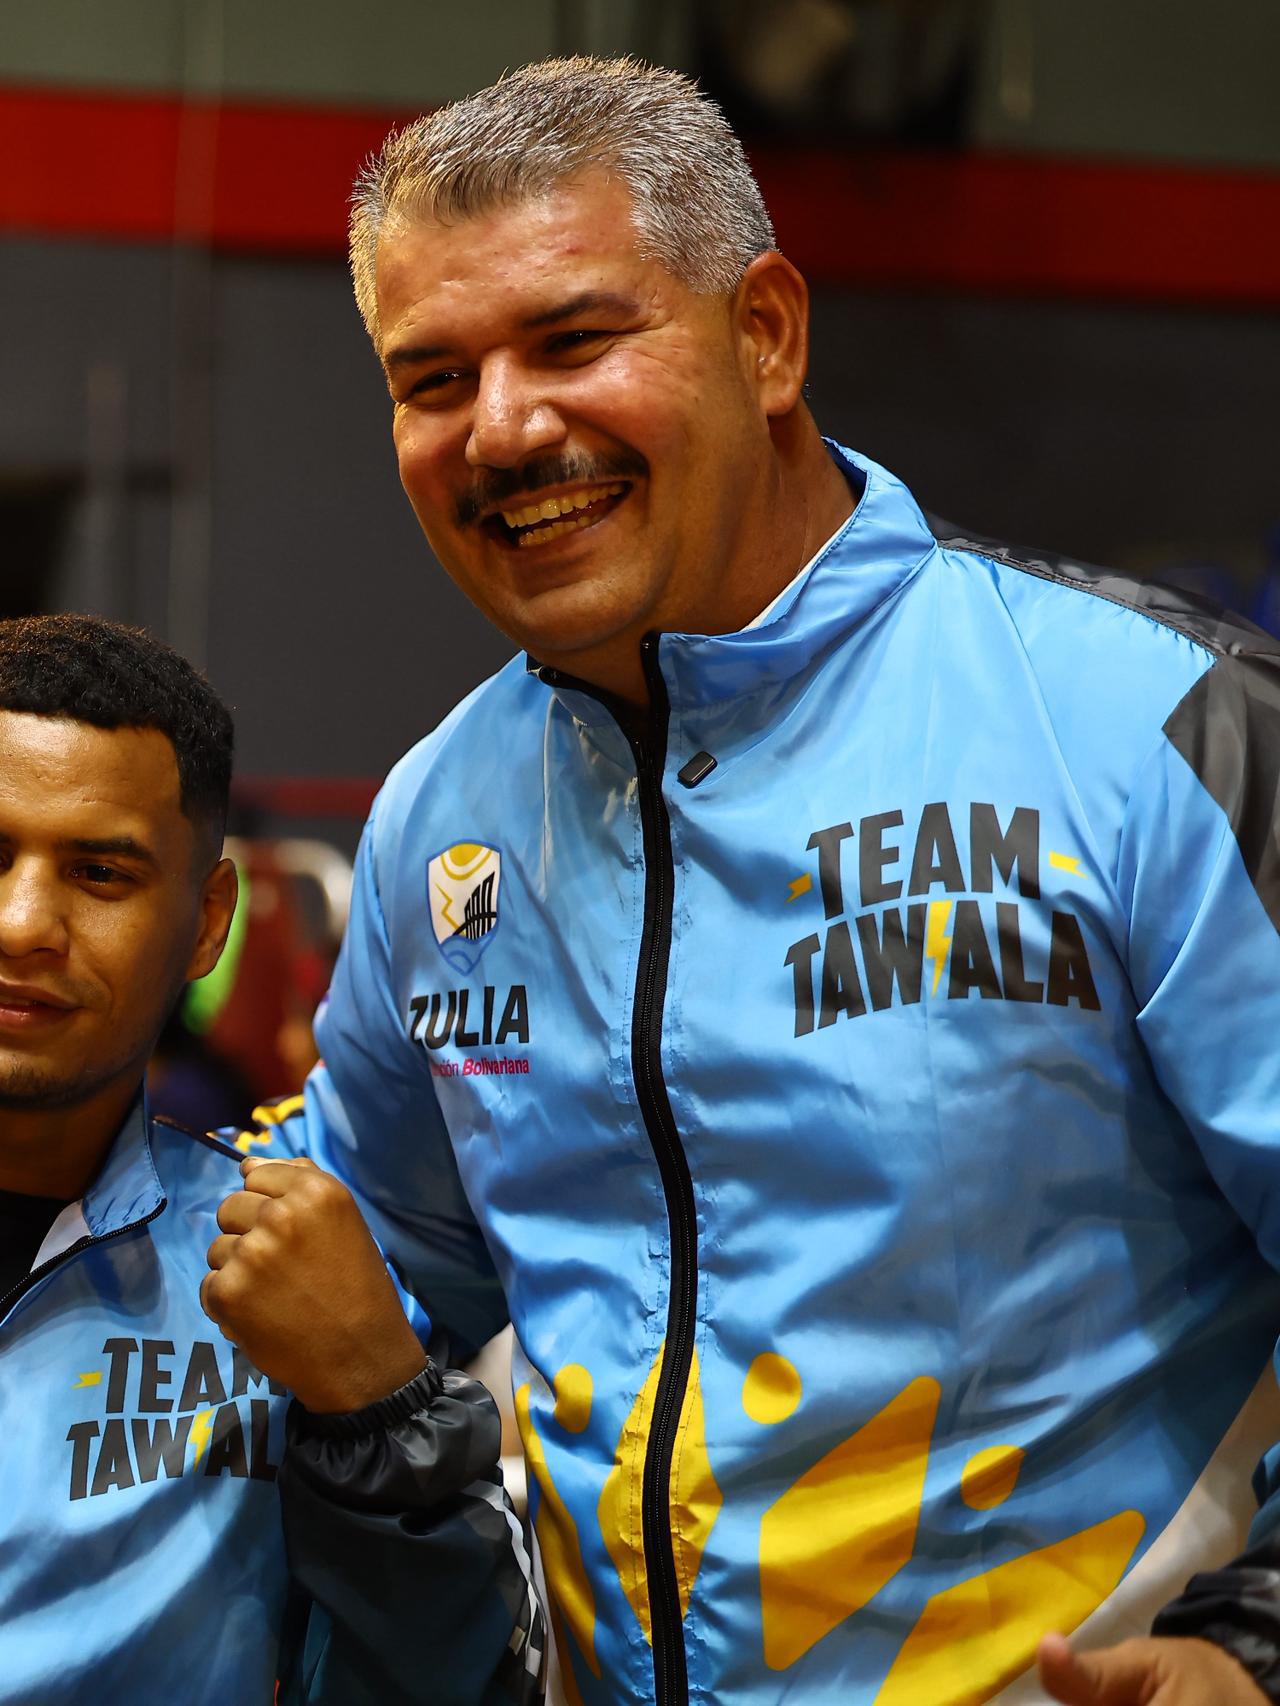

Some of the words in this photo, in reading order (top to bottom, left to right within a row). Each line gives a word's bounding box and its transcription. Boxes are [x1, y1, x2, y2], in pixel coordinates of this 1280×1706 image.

[806, 801, 1041, 920] TEAM
[409, 984, 530, 1050] ZULIA
[783, 900, 1102, 1038] TAWALA
[462, 1056, 529, 1076] Bolivariana
[66, 1399, 280, 1502] TAWAL
